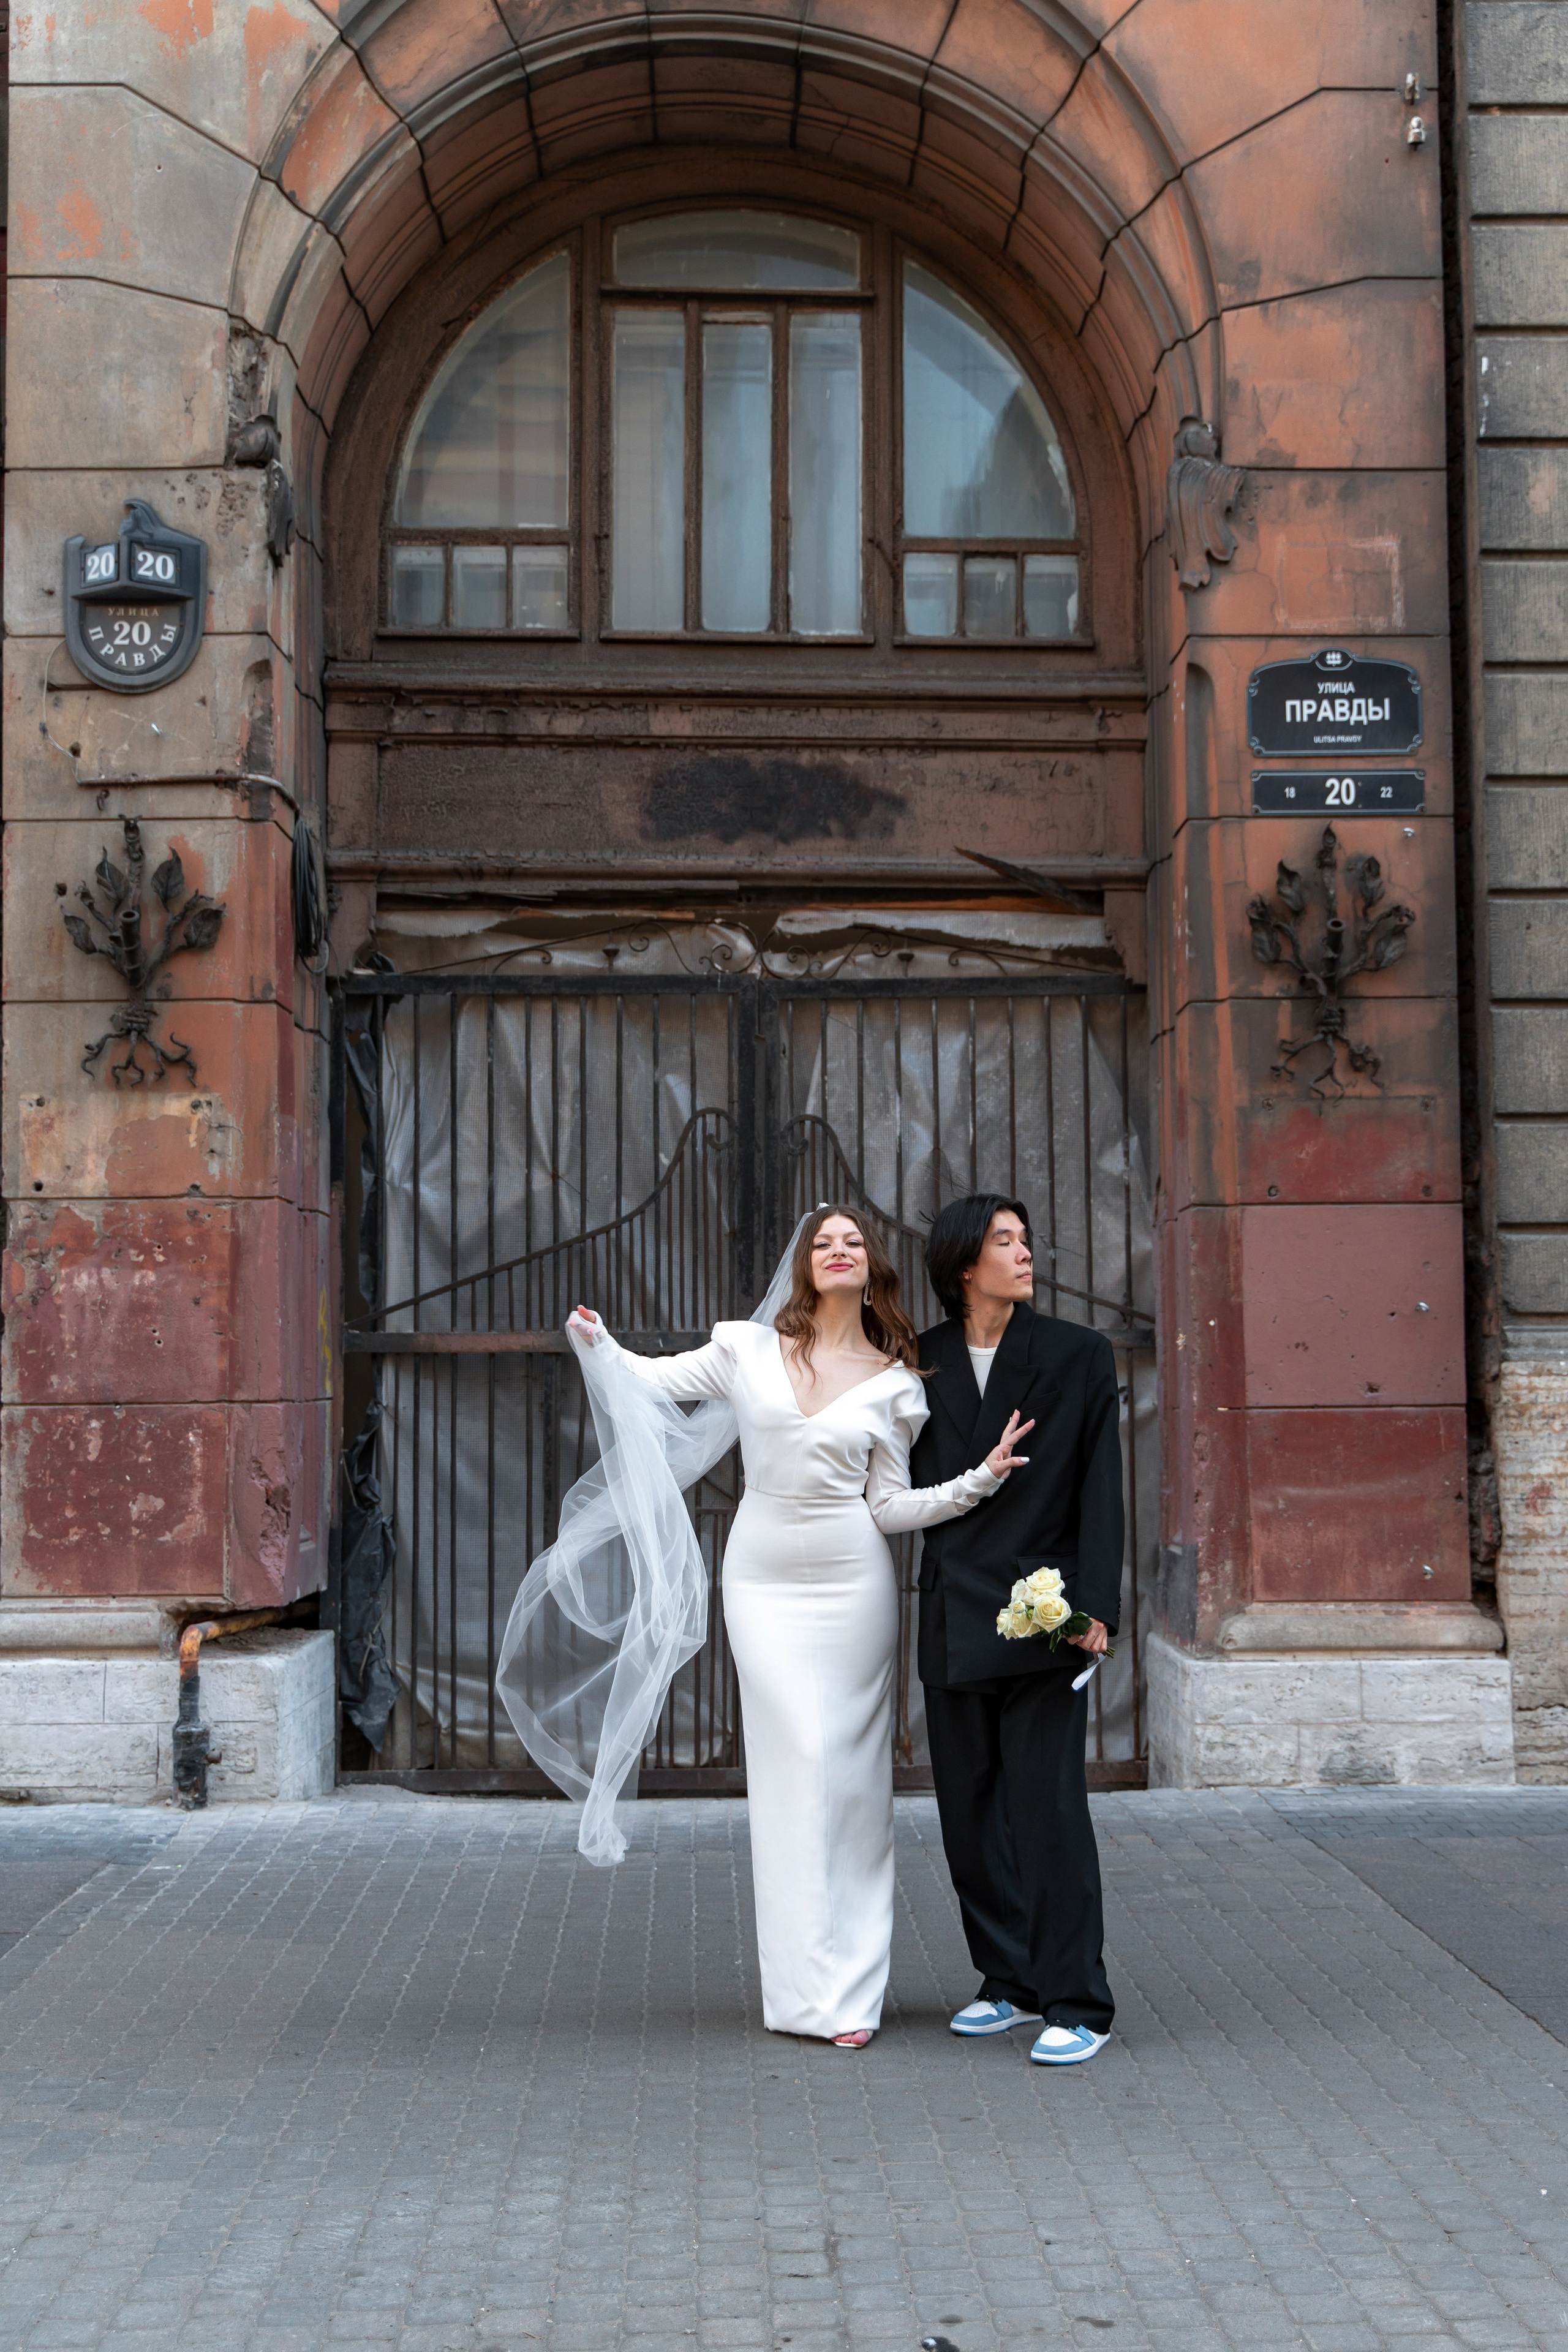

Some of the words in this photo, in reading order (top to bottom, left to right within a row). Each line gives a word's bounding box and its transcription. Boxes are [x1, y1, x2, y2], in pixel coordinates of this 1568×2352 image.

[87, 551, 115, 580] 20
[137, 552, 175, 580] 20
[107, 607, 159, 617] УЛИЦА
[89, 623, 177, 666] ПРАВДЫ
[113, 620, 151, 646] 20
[1317, 681, 1355, 695] УЛИЦА
[1285, 697, 1390, 726] ПРАВДЫ
[1284, 786, 1296, 799] 18
[1325, 777, 1356, 805] 20
[1380, 786, 1393, 798] 22
